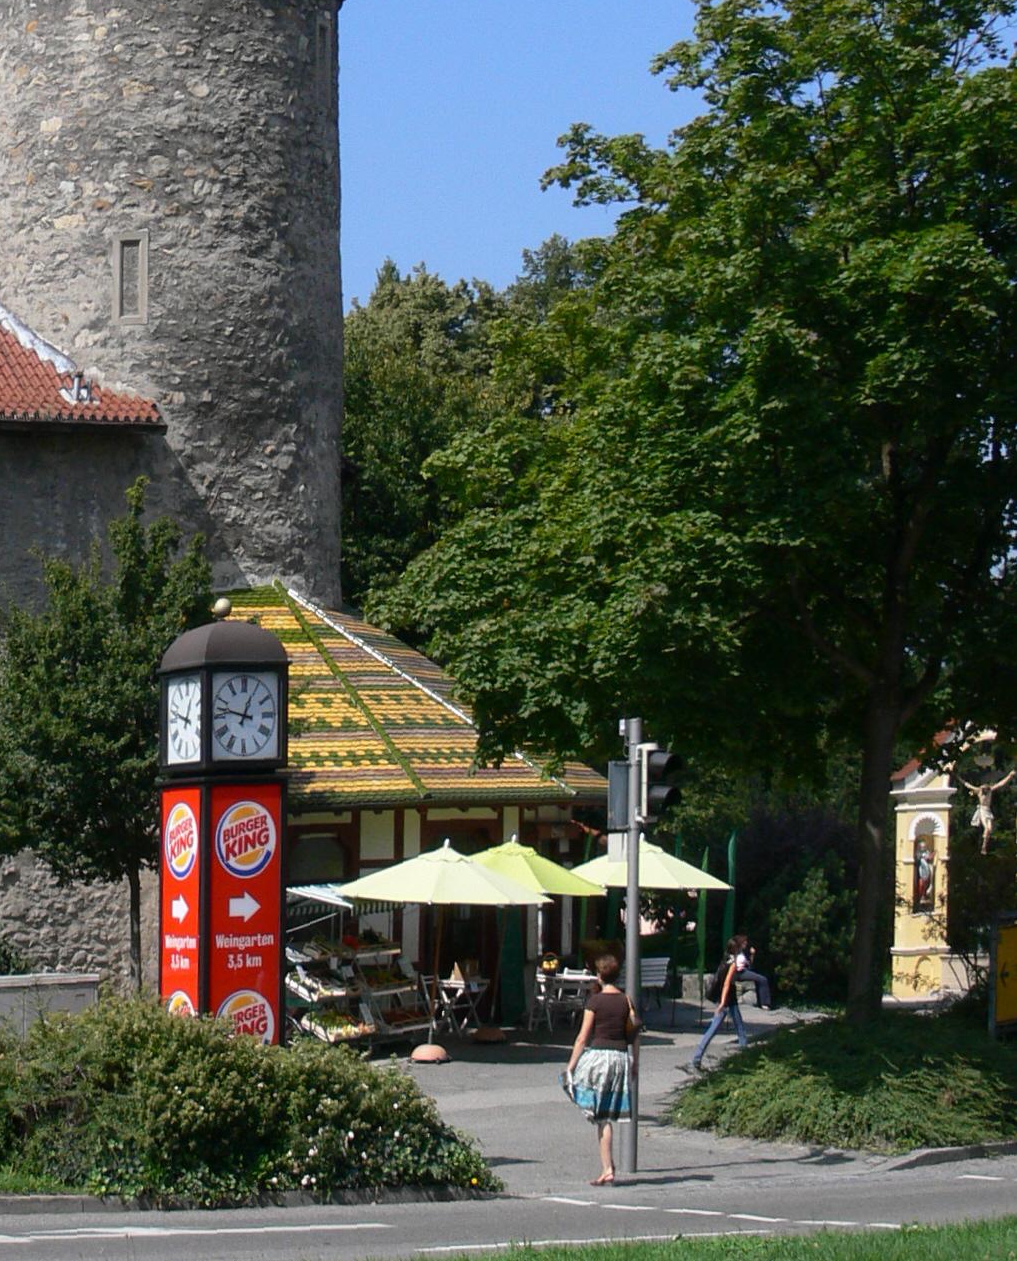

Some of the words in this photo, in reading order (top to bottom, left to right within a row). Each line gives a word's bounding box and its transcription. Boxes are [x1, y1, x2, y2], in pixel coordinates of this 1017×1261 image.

[168, 817, 193, 844] BURGER
[223, 815, 267, 843] BURGER
[170, 830, 193, 860] KING
[225, 827, 269, 861] KING
[215, 933, 274, 950] Weingarten
[227, 953, 243, 970] 3,5
[245, 953, 262, 968] km
